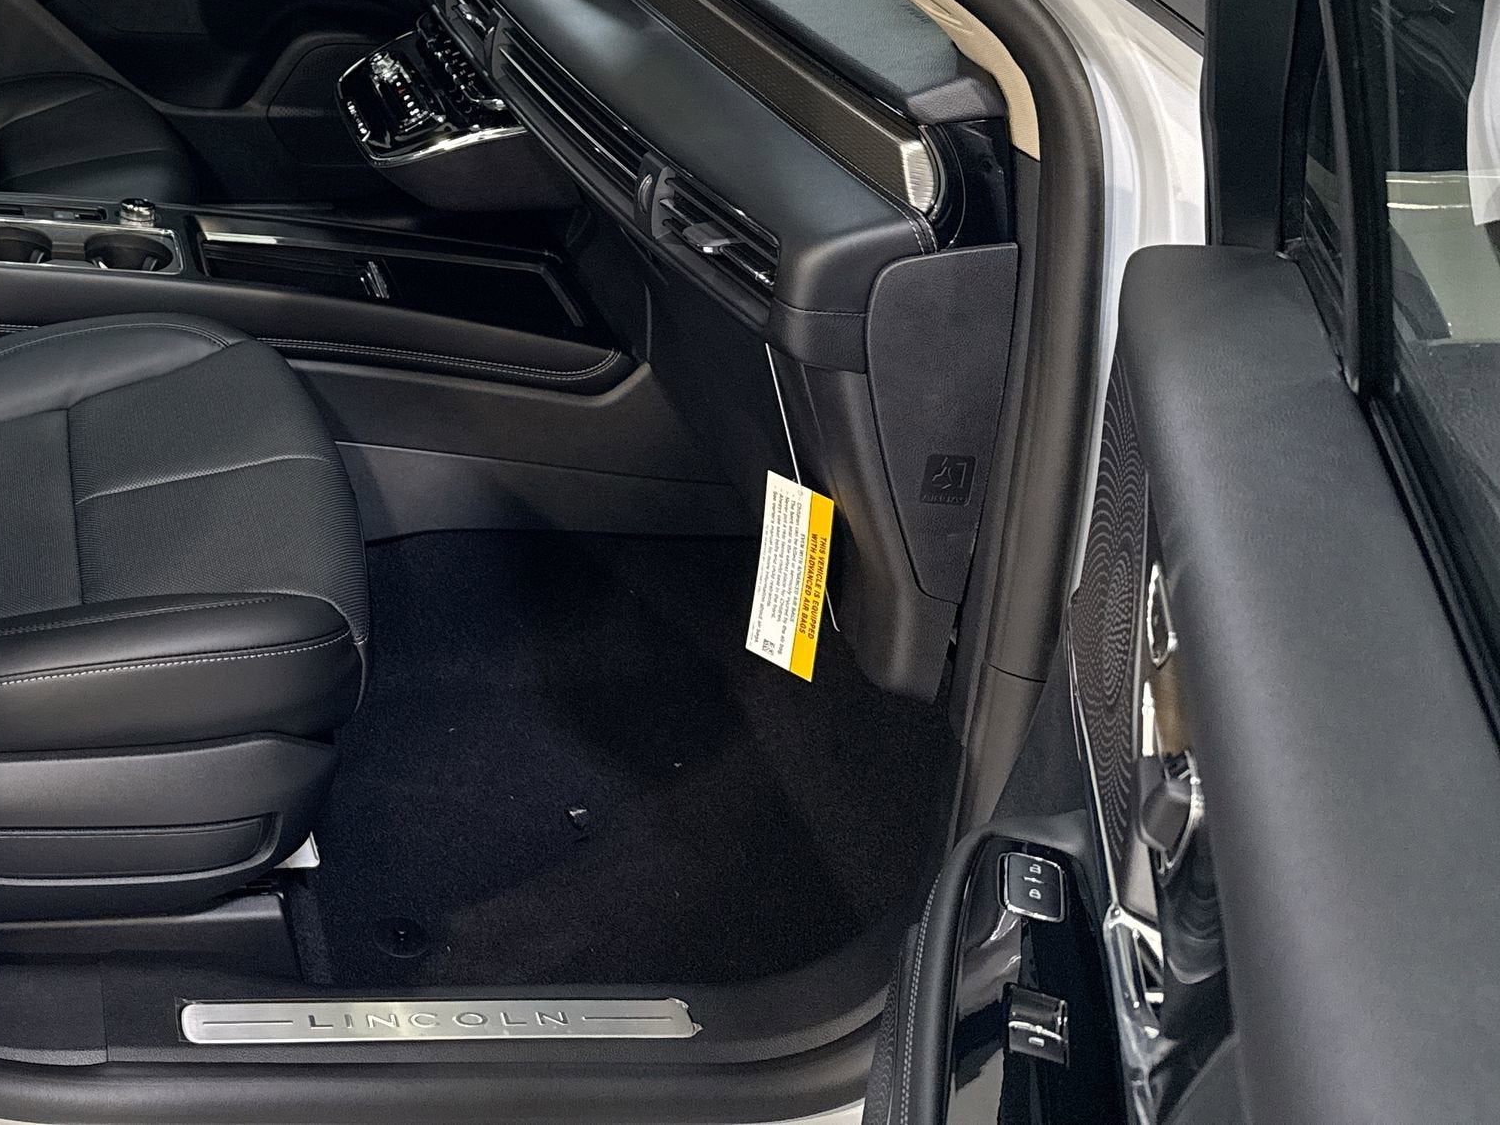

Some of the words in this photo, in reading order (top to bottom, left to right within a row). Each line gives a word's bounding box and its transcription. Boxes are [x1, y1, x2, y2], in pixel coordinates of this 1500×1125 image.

[809, 531, 818, 553] WITH
[818, 535, 826, 555] THIS
[804, 553, 815, 596] ADVANCED
[814, 555, 824, 589] VEHICLE
[813, 589, 820, 599] IS
[807, 599, 818, 641] EQUIPPED
[308, 1011, 570, 1031] LINCOLN
